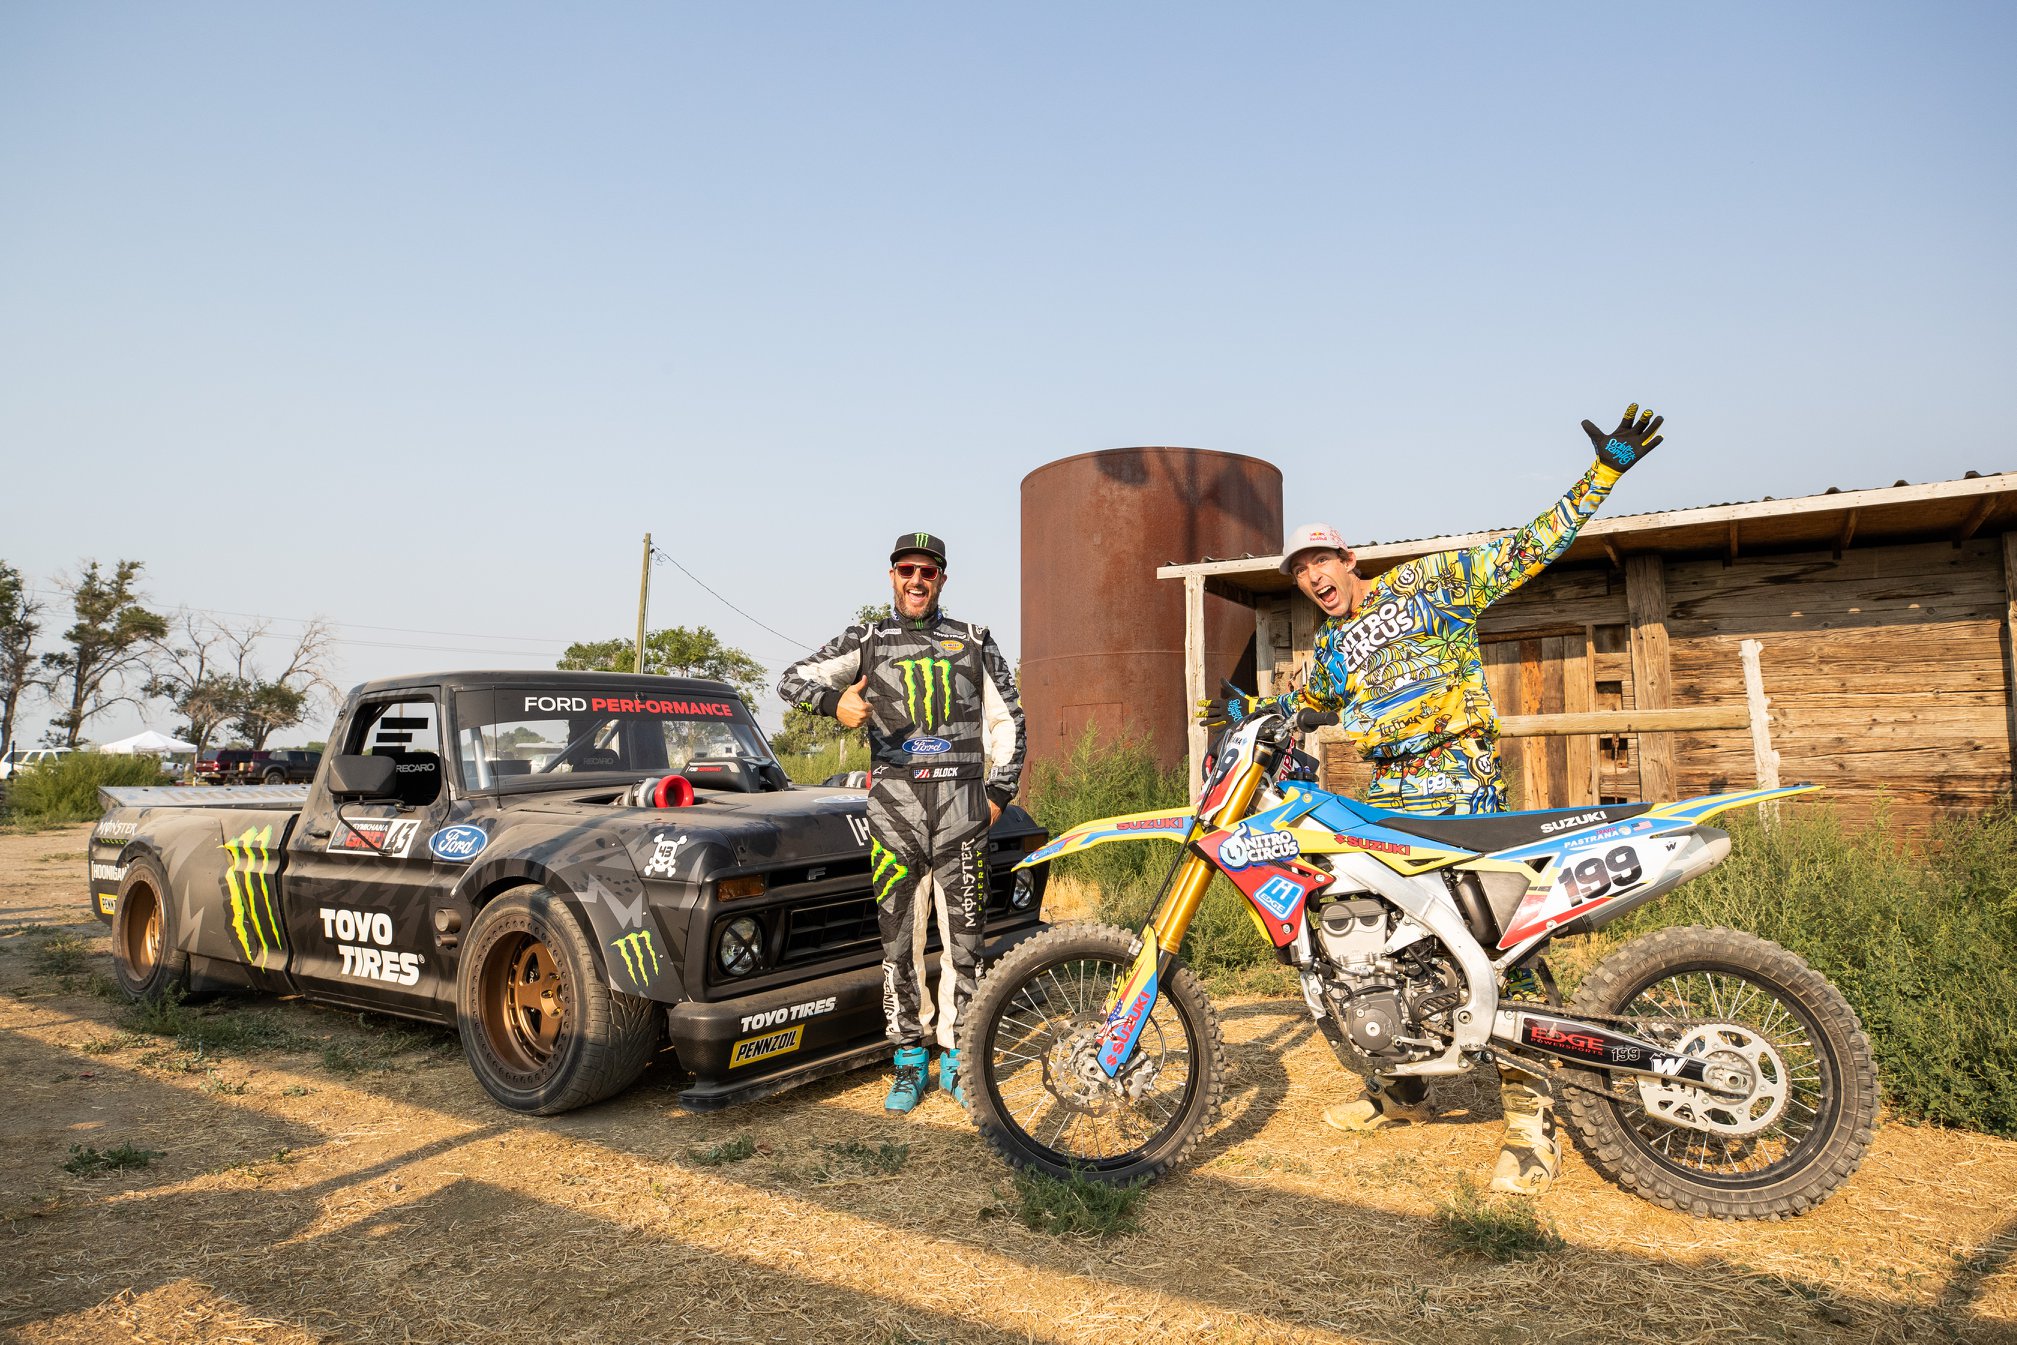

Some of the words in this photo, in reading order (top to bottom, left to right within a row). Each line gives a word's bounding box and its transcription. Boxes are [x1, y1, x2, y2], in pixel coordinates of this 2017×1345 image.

[1339, 603, 1397, 660] NITRO
[1346, 610, 1413, 673] CIRCUS
[524, 696, 587, 712] FORD
[592, 697, 733, 717] PERFORMANCE
[911, 739, 942, 752] Ford
[396, 763, 435, 773] RECARO
[932, 767, 959, 778] BLOCK
[1420, 773, 1446, 796] 199
[1117, 816, 1183, 831] SUZUKI
[1540, 810, 1607, 834] SUZUKI
[1596, 826, 1616, 835] TRAVIS
[438, 828, 478, 854] Ford
[1244, 830, 1292, 850] NITRO
[1347, 835, 1411, 856] SUZUKI
[1564, 830, 1619, 848] PASTRANA
[658, 845, 672, 858] 43
[1247, 841, 1298, 862] CIRCUS
[1558, 845, 1643, 908] 199
[1260, 893, 1286, 913] EDGE
[320, 907, 392, 945] TOYO
[741, 1007, 788, 1033] TOYO
[790, 996, 837, 1021] TIRES
[1112, 991, 1151, 1055] SUZUKI
[736, 1030, 797, 1062] PENNZOIL
[1530, 1037, 1604, 1056] POWERSPORTS
[1531, 1026, 1605, 1051] EDGE
[1612, 1046, 1641, 1062] 199
